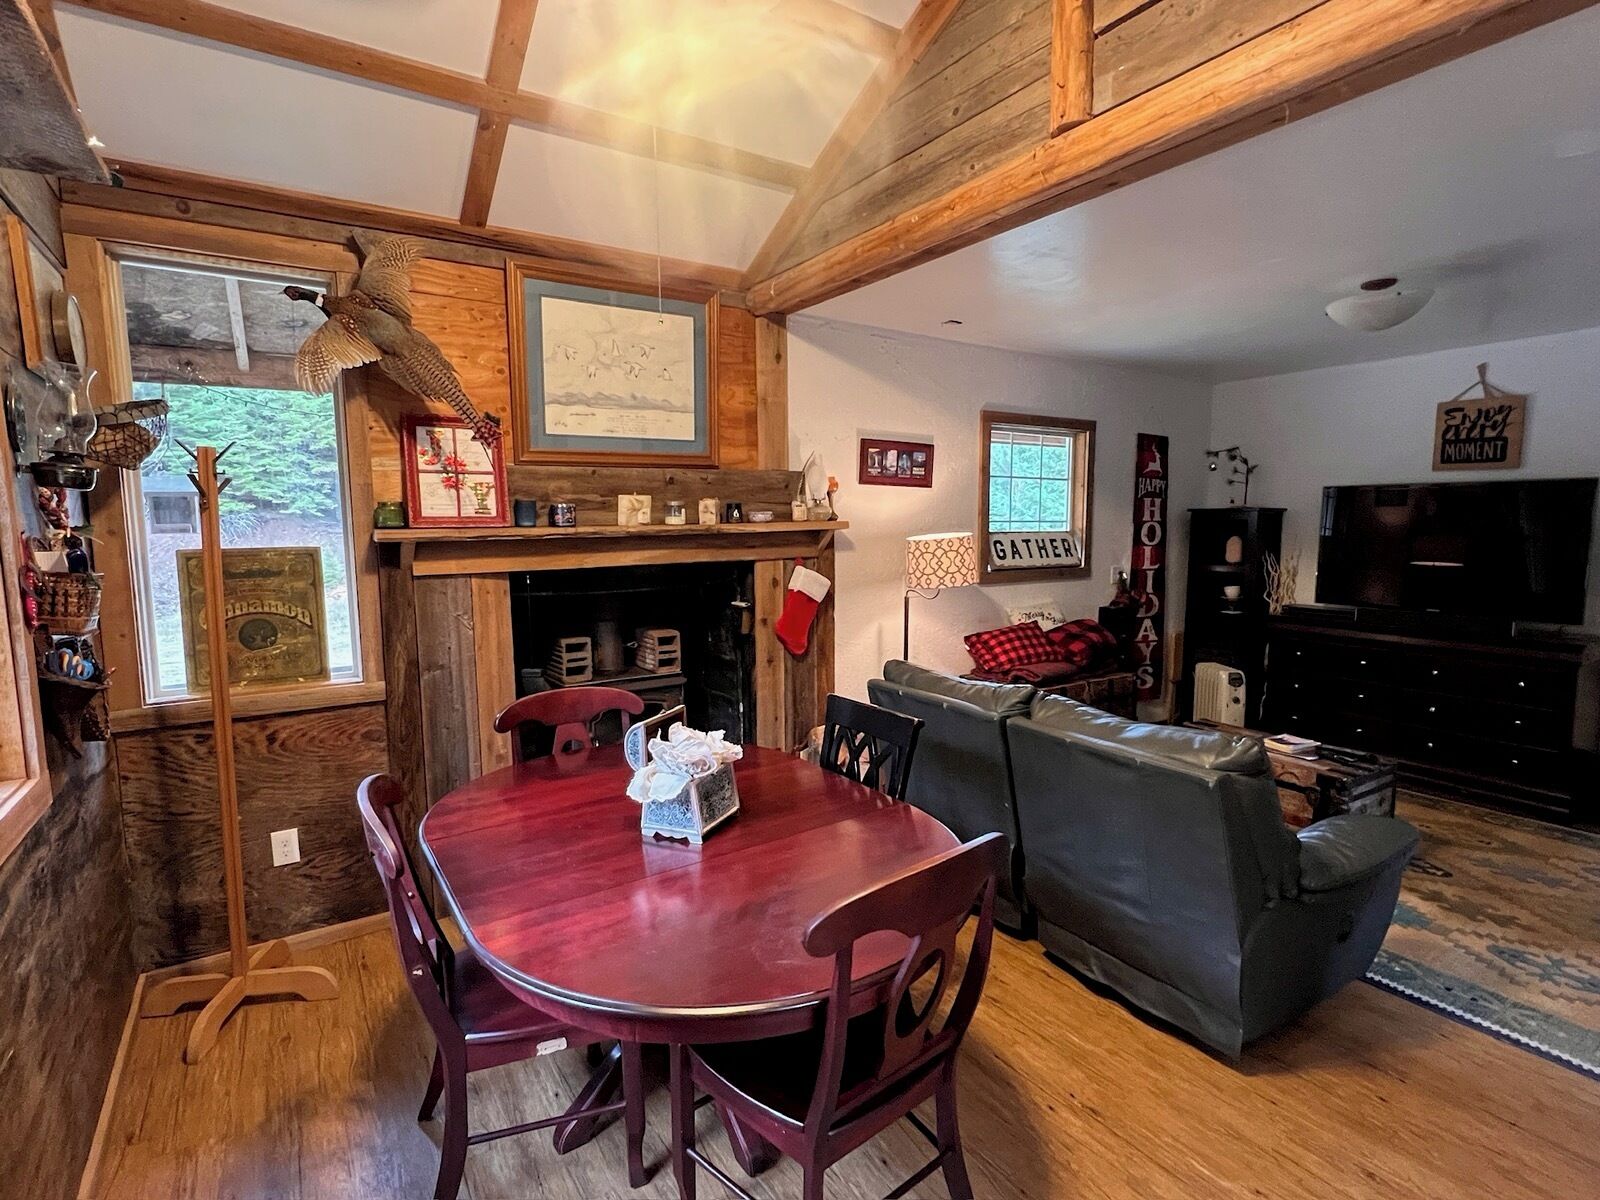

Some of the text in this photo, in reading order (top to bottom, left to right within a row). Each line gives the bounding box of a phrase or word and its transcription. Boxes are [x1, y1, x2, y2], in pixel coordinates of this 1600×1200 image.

[1444, 441, 1504, 461] MOMENT
[1138, 477, 1167, 499] HAPPY
[992, 538, 1074, 561] GATHER
[1134, 498, 1162, 689] HOLIDAYS
